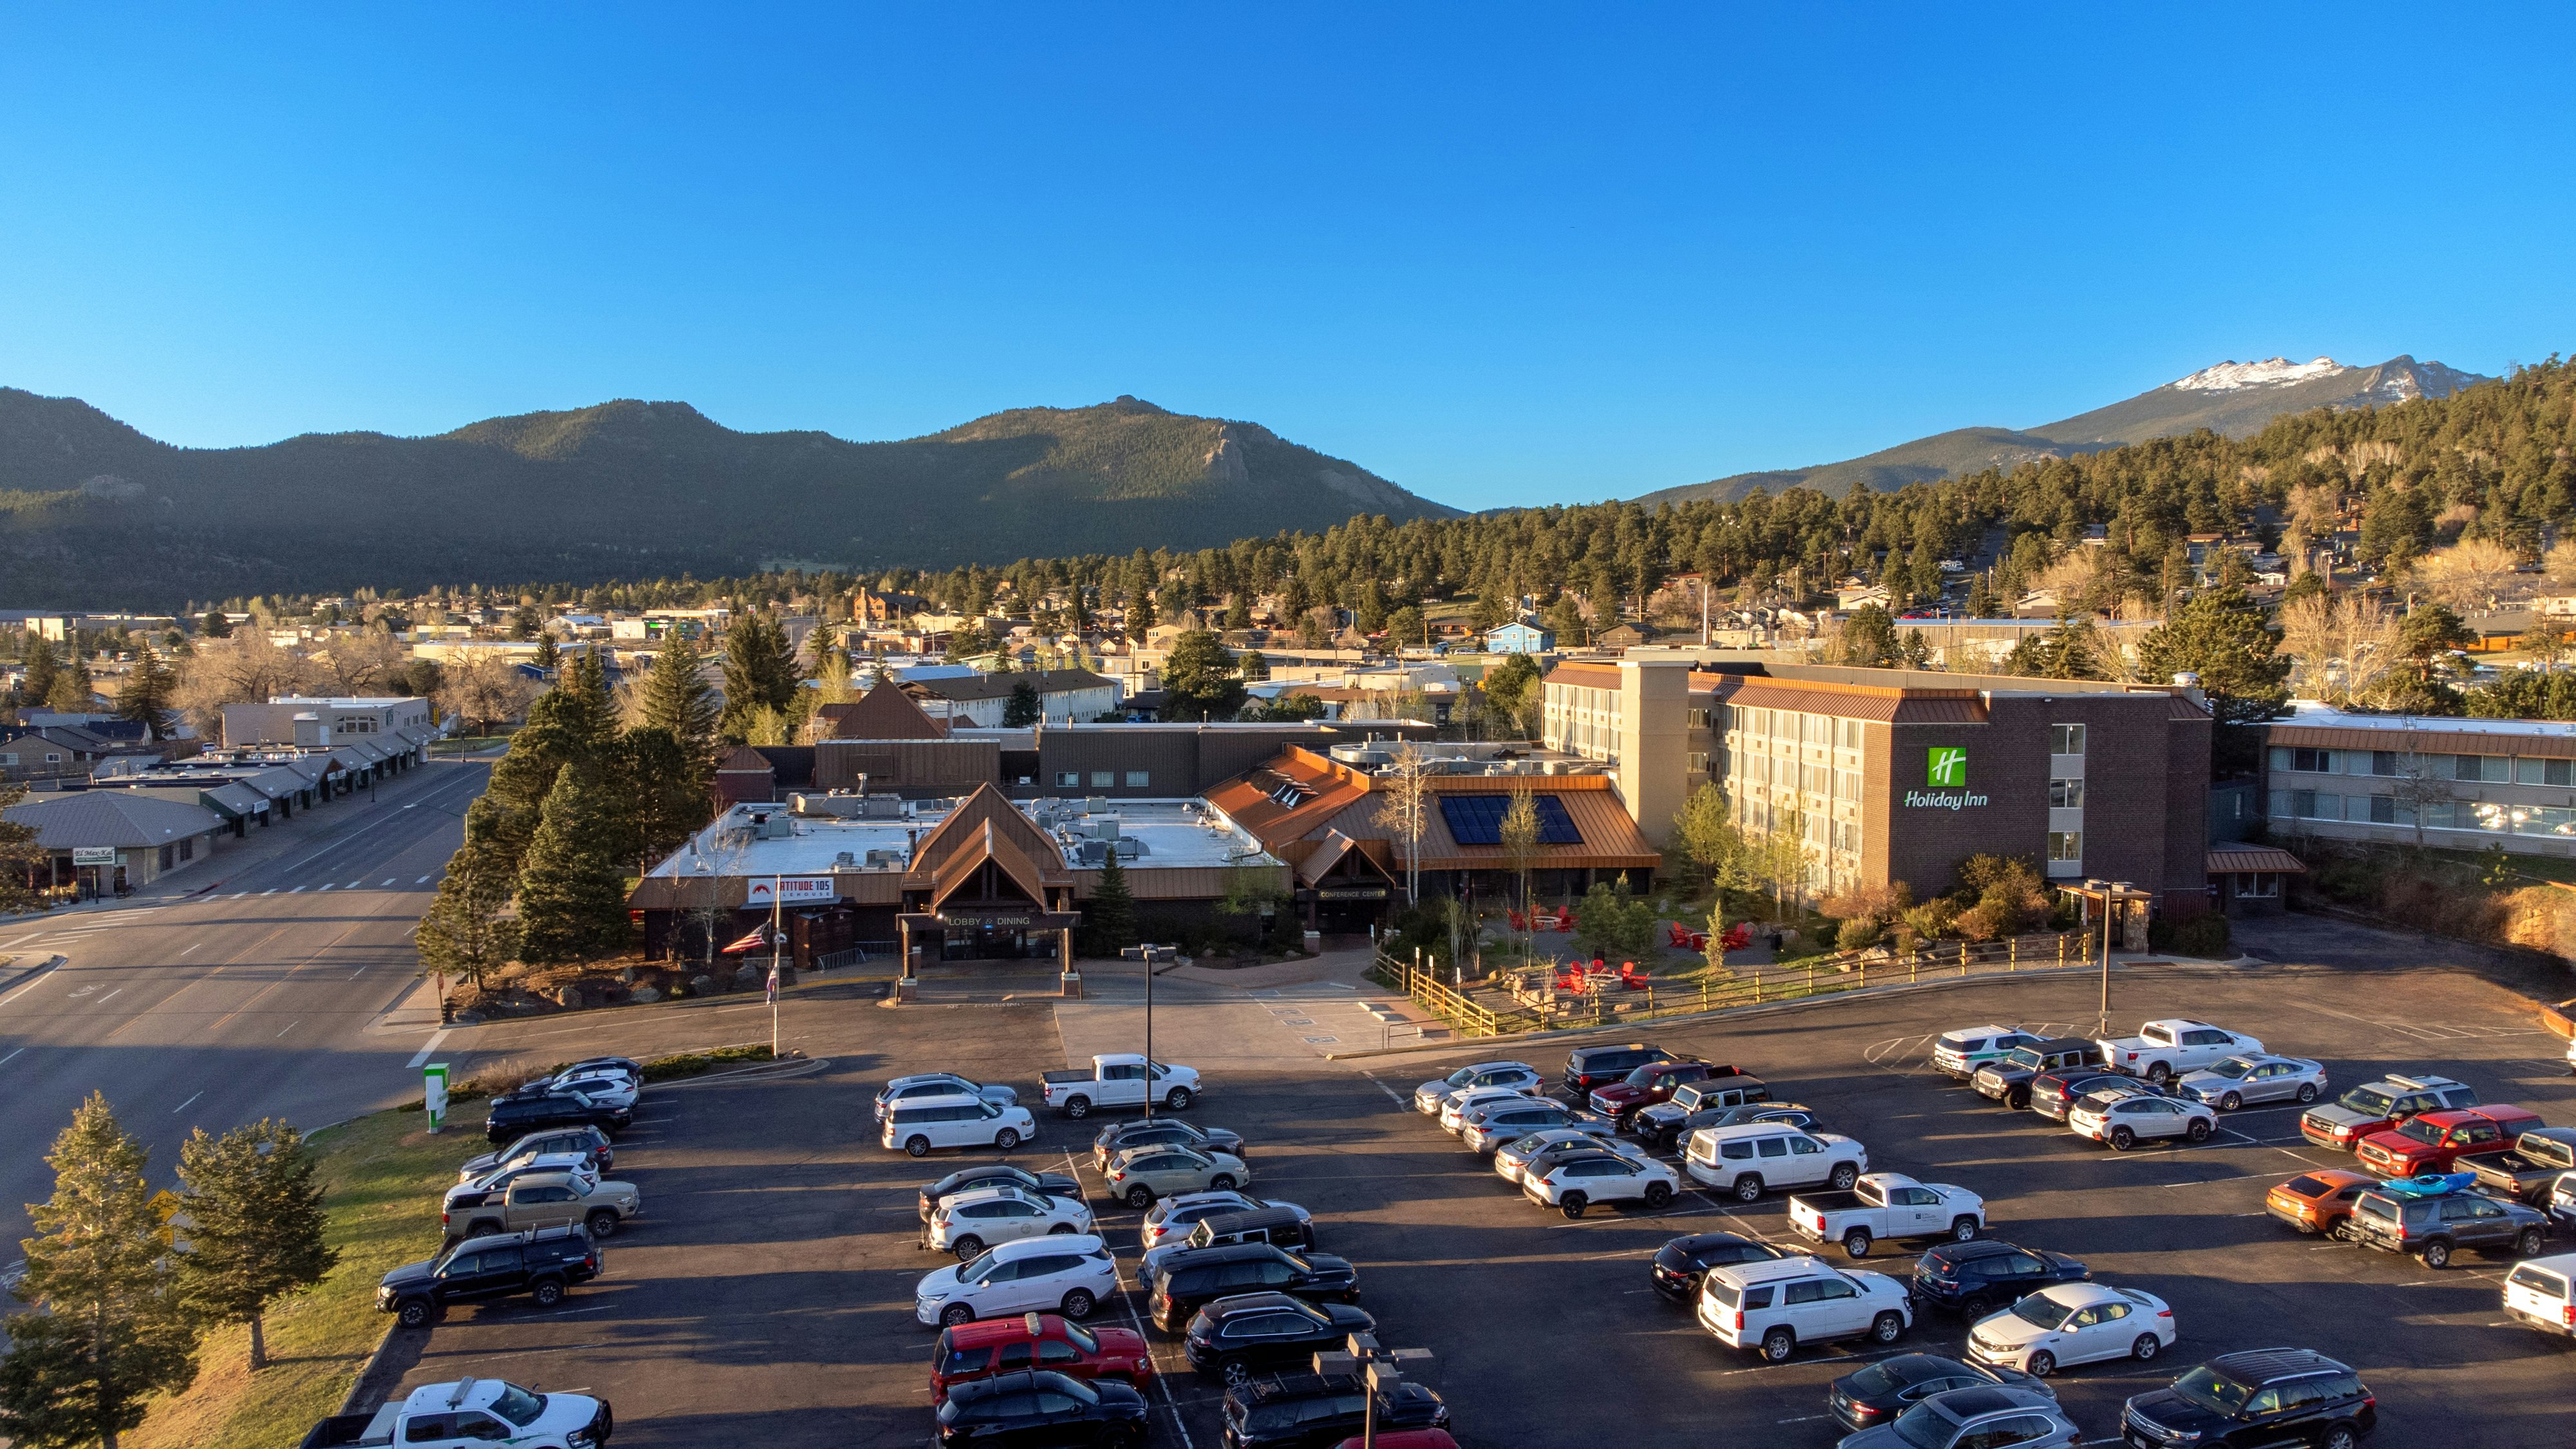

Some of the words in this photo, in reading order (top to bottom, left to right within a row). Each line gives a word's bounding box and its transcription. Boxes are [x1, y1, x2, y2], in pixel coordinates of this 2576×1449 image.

[1904, 791, 1963, 811] Holiday
[1964, 791, 1988, 806] Inn
[815, 880, 829, 891] 105
[949, 918, 981, 926] LOBBY
[997, 917, 1030, 925] DINING
